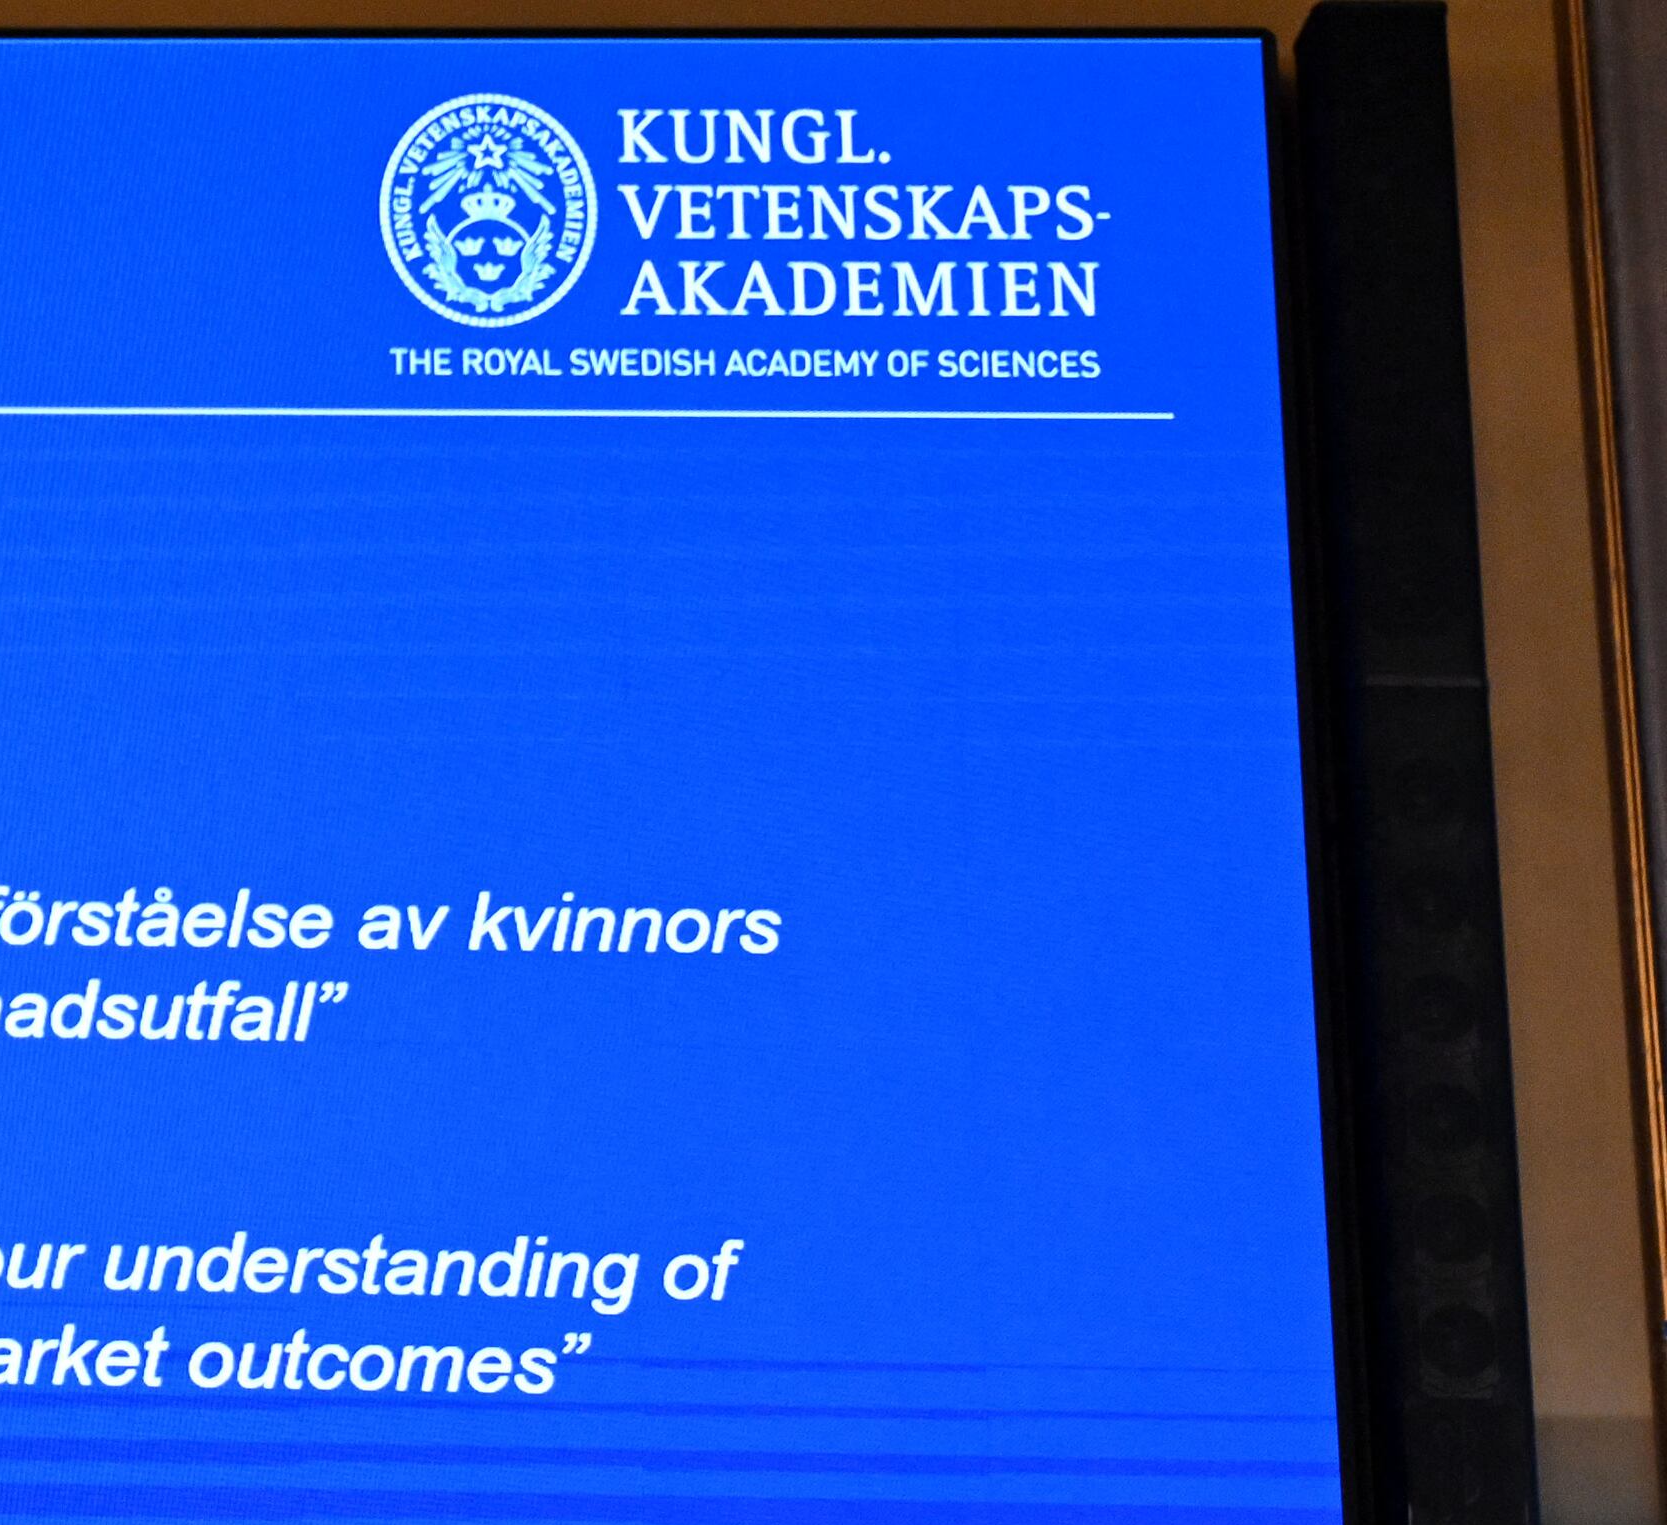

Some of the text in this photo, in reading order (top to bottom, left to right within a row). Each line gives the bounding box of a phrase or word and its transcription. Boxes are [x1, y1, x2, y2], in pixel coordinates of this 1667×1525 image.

[619, 109, 890, 163] KUNGL.
[392, 105, 586, 263] KUNGL. VETENSKAPSAKADEMIEN
[618, 185, 1110, 240] VETENSKAPS-
[621, 261, 1098, 316] AKADEMIEN
[391, 349, 1100, 378] THE ROYAL SWEDISH ACADEMY OF SCIENCES
[359, 905, 449, 950] av
[469, 891, 781, 954] kvinnors
[104, 1232, 639, 1314] understanding
[664, 1240, 744, 1300] of
[189, 1331, 593, 1394] outcomes”
